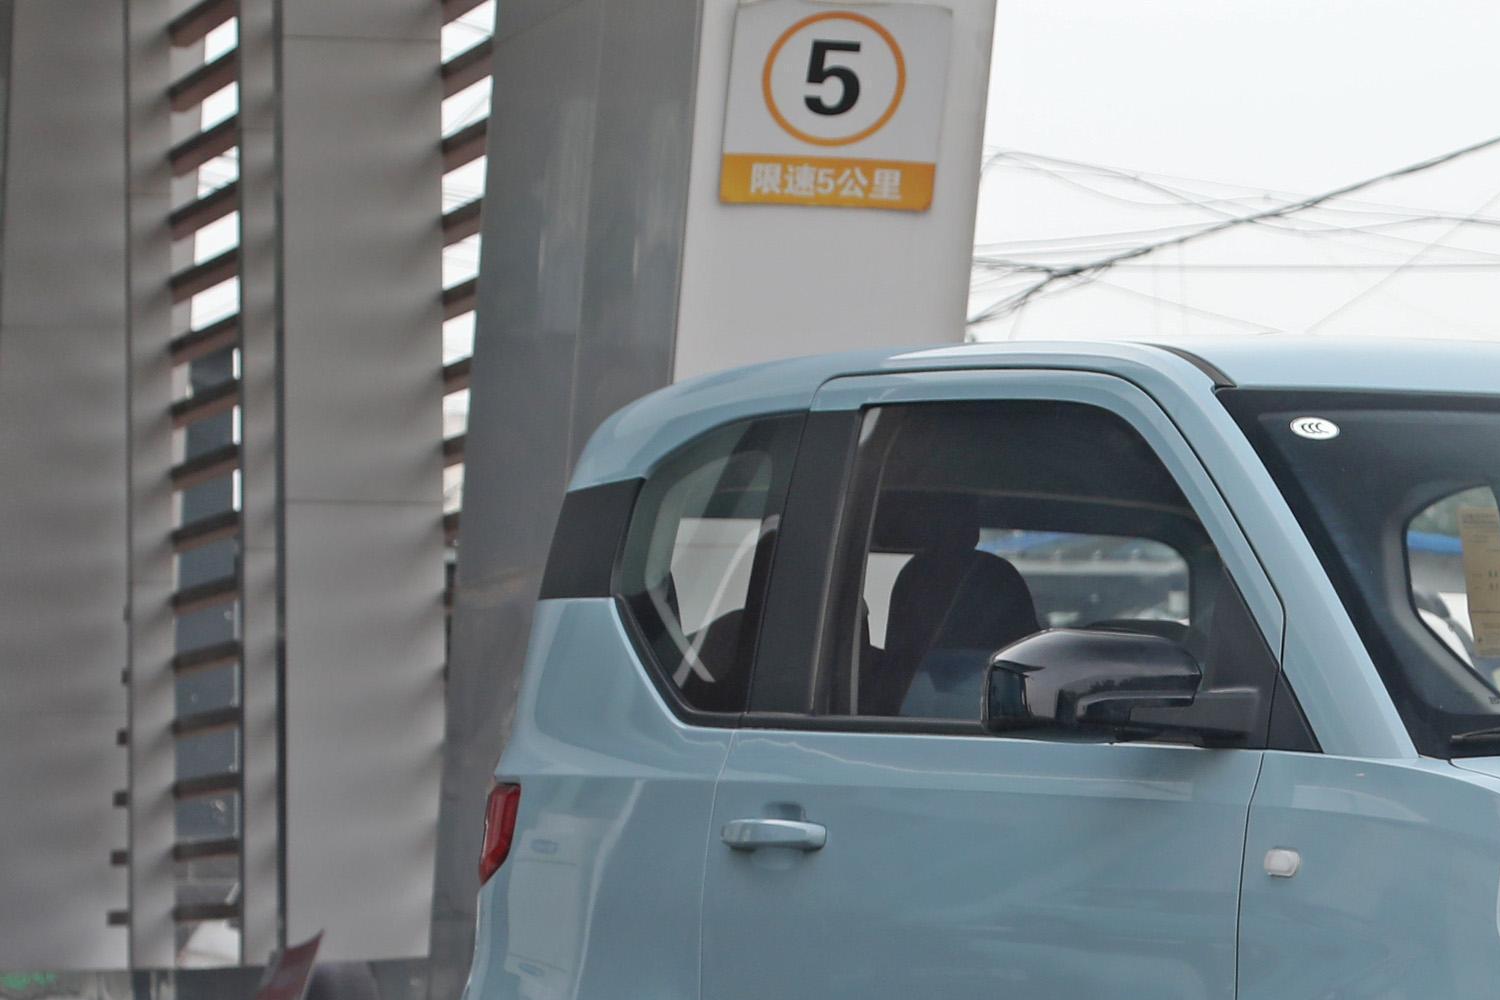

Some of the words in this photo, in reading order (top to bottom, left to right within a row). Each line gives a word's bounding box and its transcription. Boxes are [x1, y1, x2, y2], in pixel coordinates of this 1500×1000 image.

[803, 39, 861, 116] 5
[750, 162, 902, 201] 限速5公里
